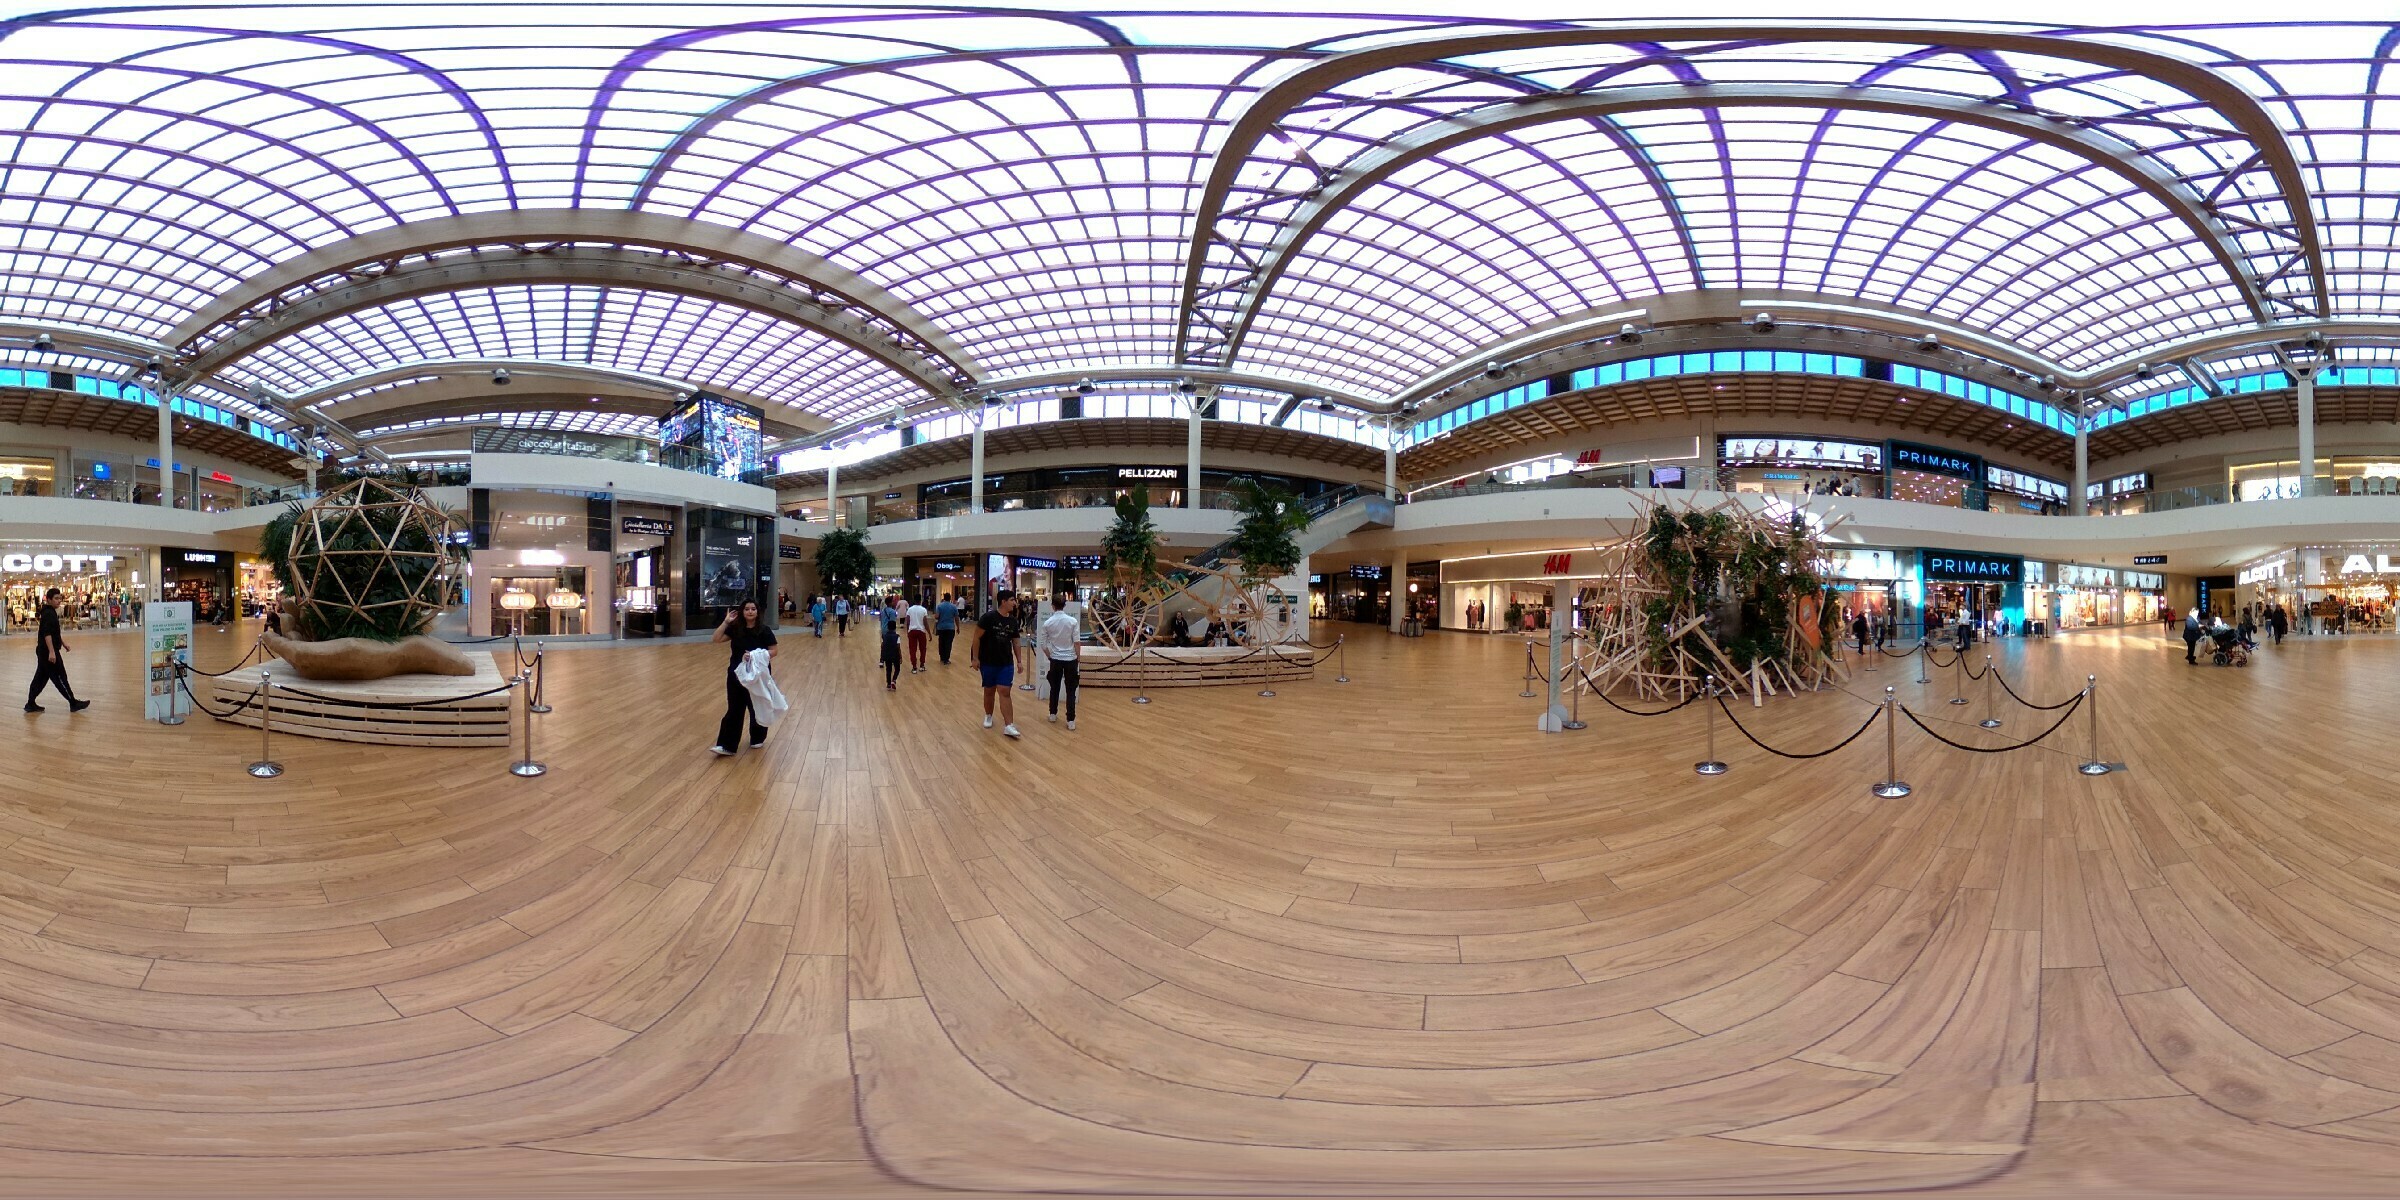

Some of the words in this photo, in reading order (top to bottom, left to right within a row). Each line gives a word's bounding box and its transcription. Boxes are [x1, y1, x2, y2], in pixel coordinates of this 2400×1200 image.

[1577, 449, 1601, 466] H&M
[1899, 450, 1970, 472] PRIMARK
[1118, 468, 1178, 479] PELLIZZARI
[0, 553, 114, 573] COTT
[942, 563, 953, 571] bag
[1020, 558, 1057, 569] VESTOPAZZO
[1543, 554, 1571, 575] H&M
[1932, 558, 2011, 576] PRIMARK
[2238, 559, 2286, 585] ALCOTT
